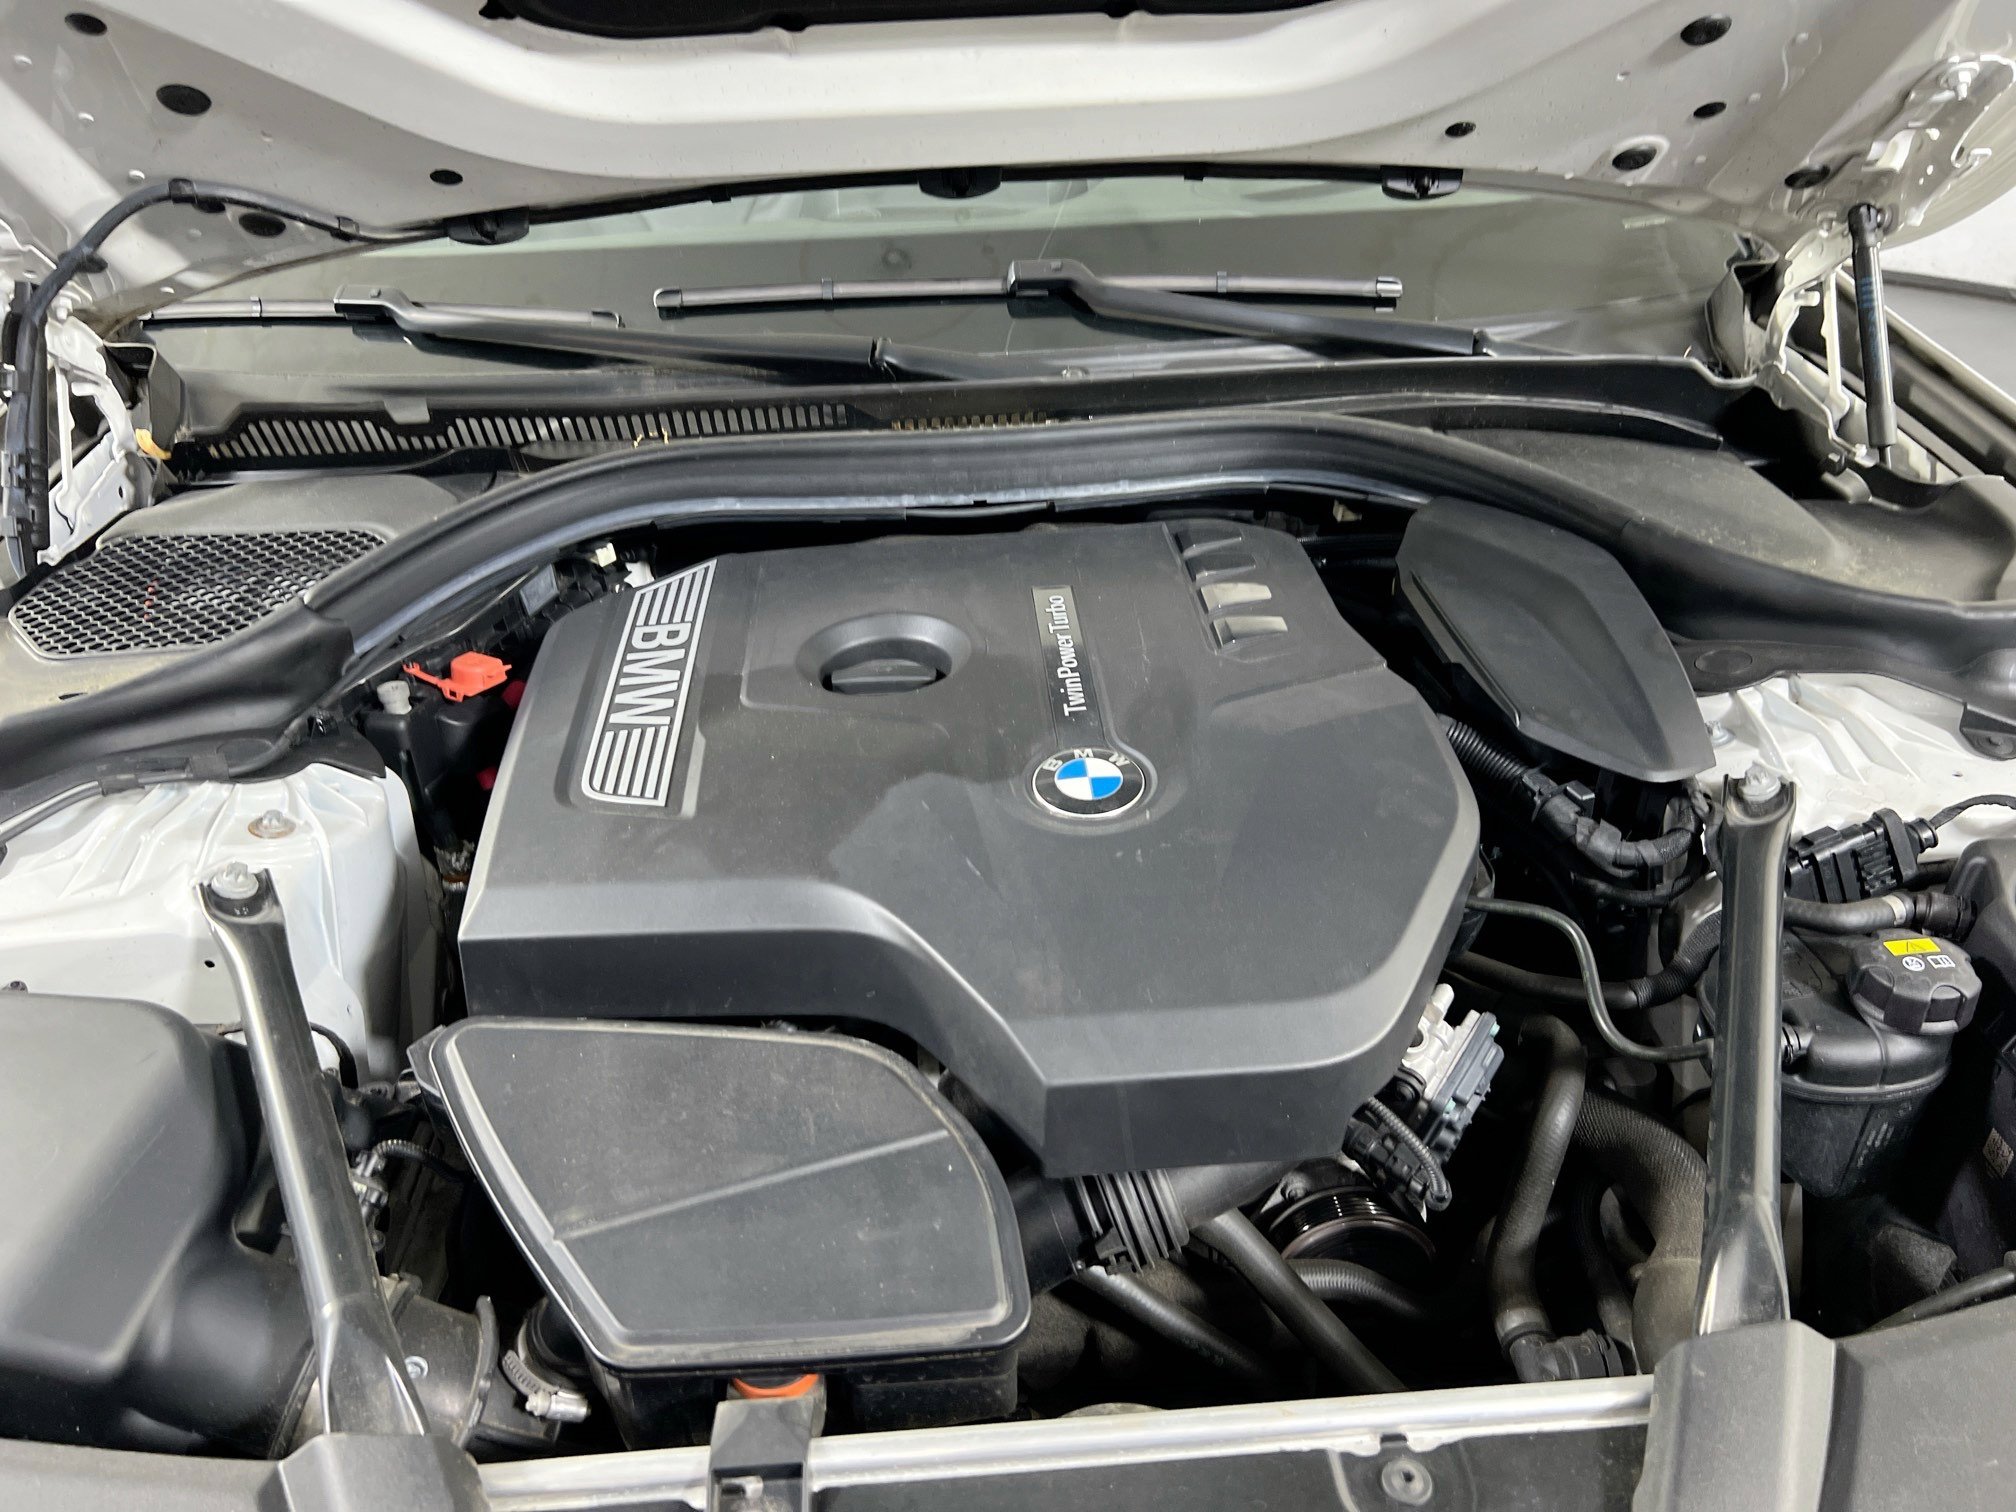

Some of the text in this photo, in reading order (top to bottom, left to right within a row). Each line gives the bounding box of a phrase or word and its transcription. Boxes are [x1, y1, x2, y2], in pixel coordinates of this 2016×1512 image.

[608, 622, 693, 725] BMW
[1045, 594, 1088, 717] TwinPower Turbo
[1042, 748, 1131, 772] BMW
